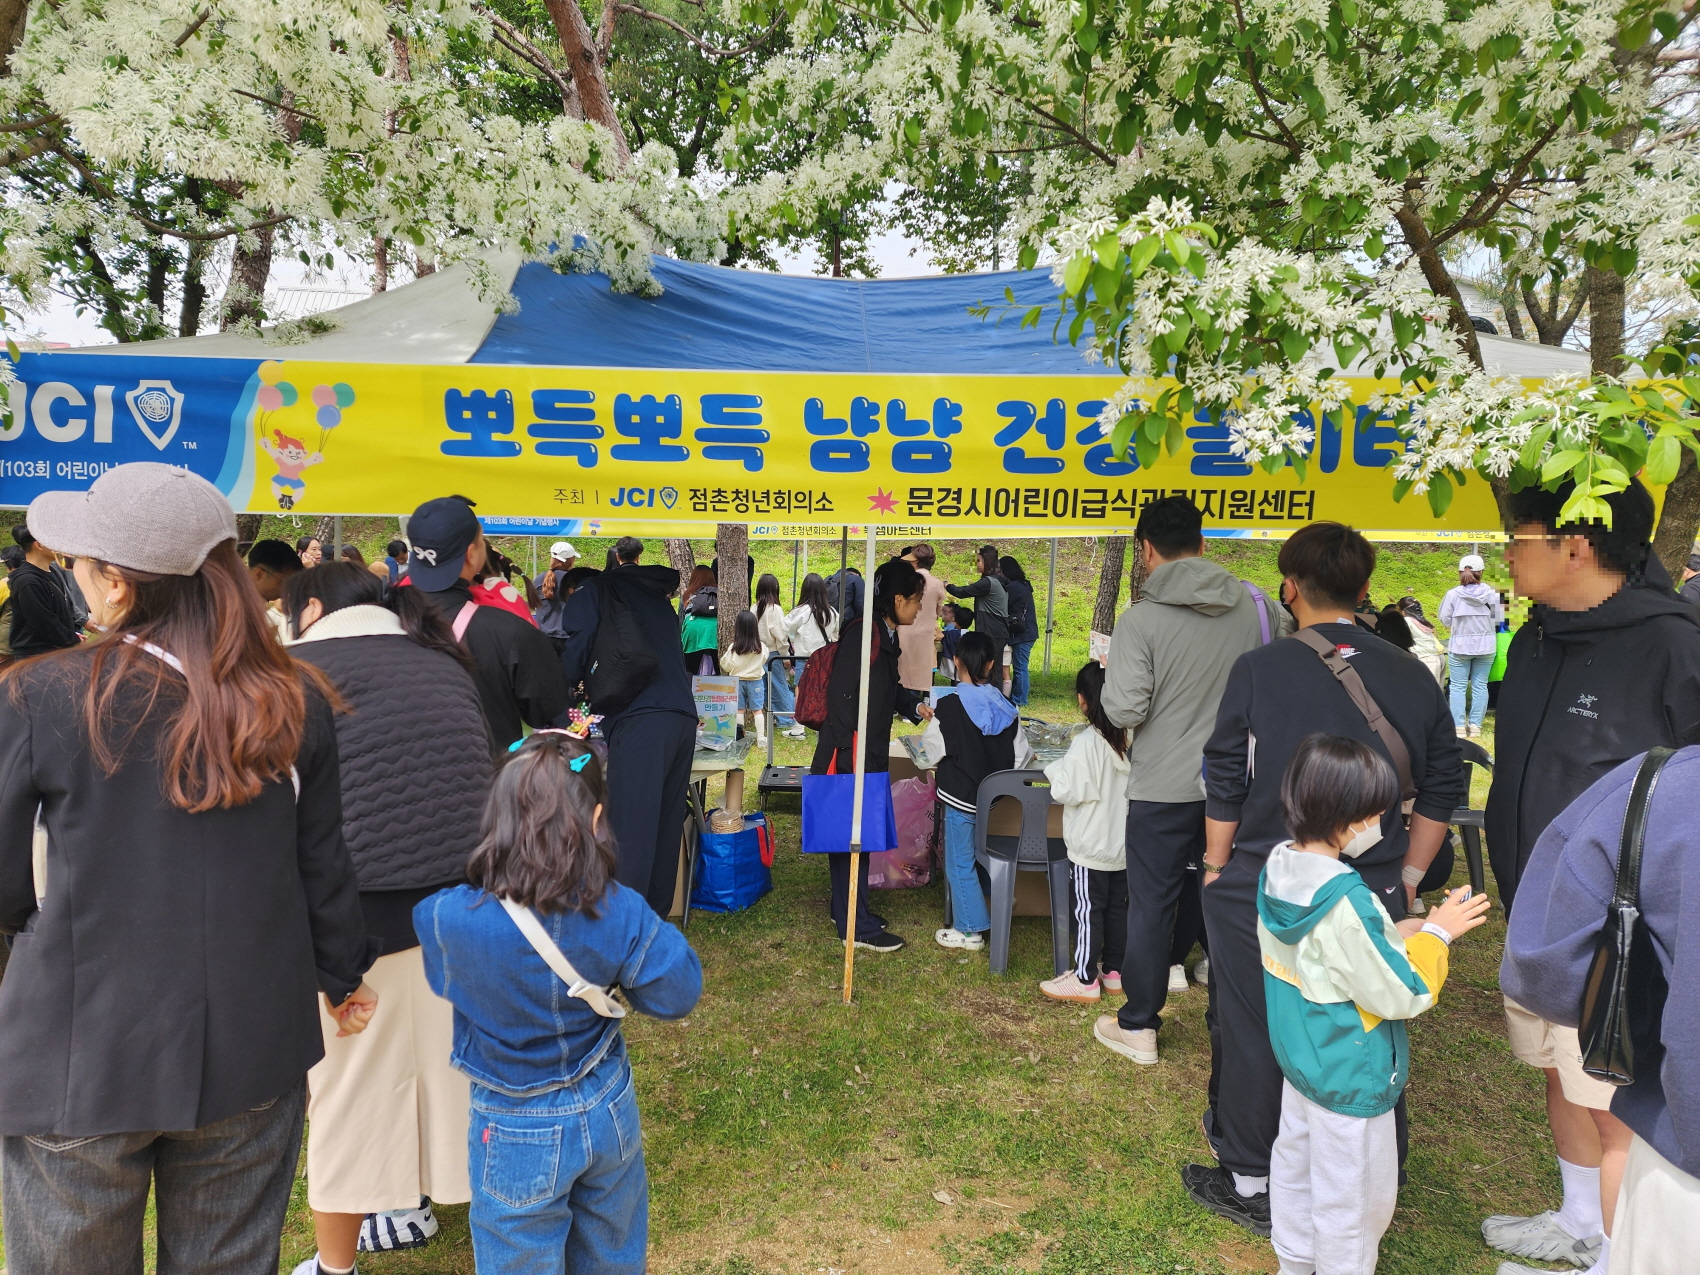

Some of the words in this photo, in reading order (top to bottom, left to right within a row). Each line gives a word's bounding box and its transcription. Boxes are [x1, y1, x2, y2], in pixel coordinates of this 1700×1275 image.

[440, 388, 770, 472] 뽀득뽀득
[804, 396, 963, 474] 냠냠
[182, 441, 197, 450] TM
[0, 460, 50, 479] 103회
[553, 488, 585, 505] 주최
[609, 487, 655, 508] JCI
[688, 487, 835, 514] 점촌청년회의소
[752, 526, 770, 535] JCI
[781, 526, 837, 536] 점촌청년회의소
[704, 703, 726, 712] 만들기
